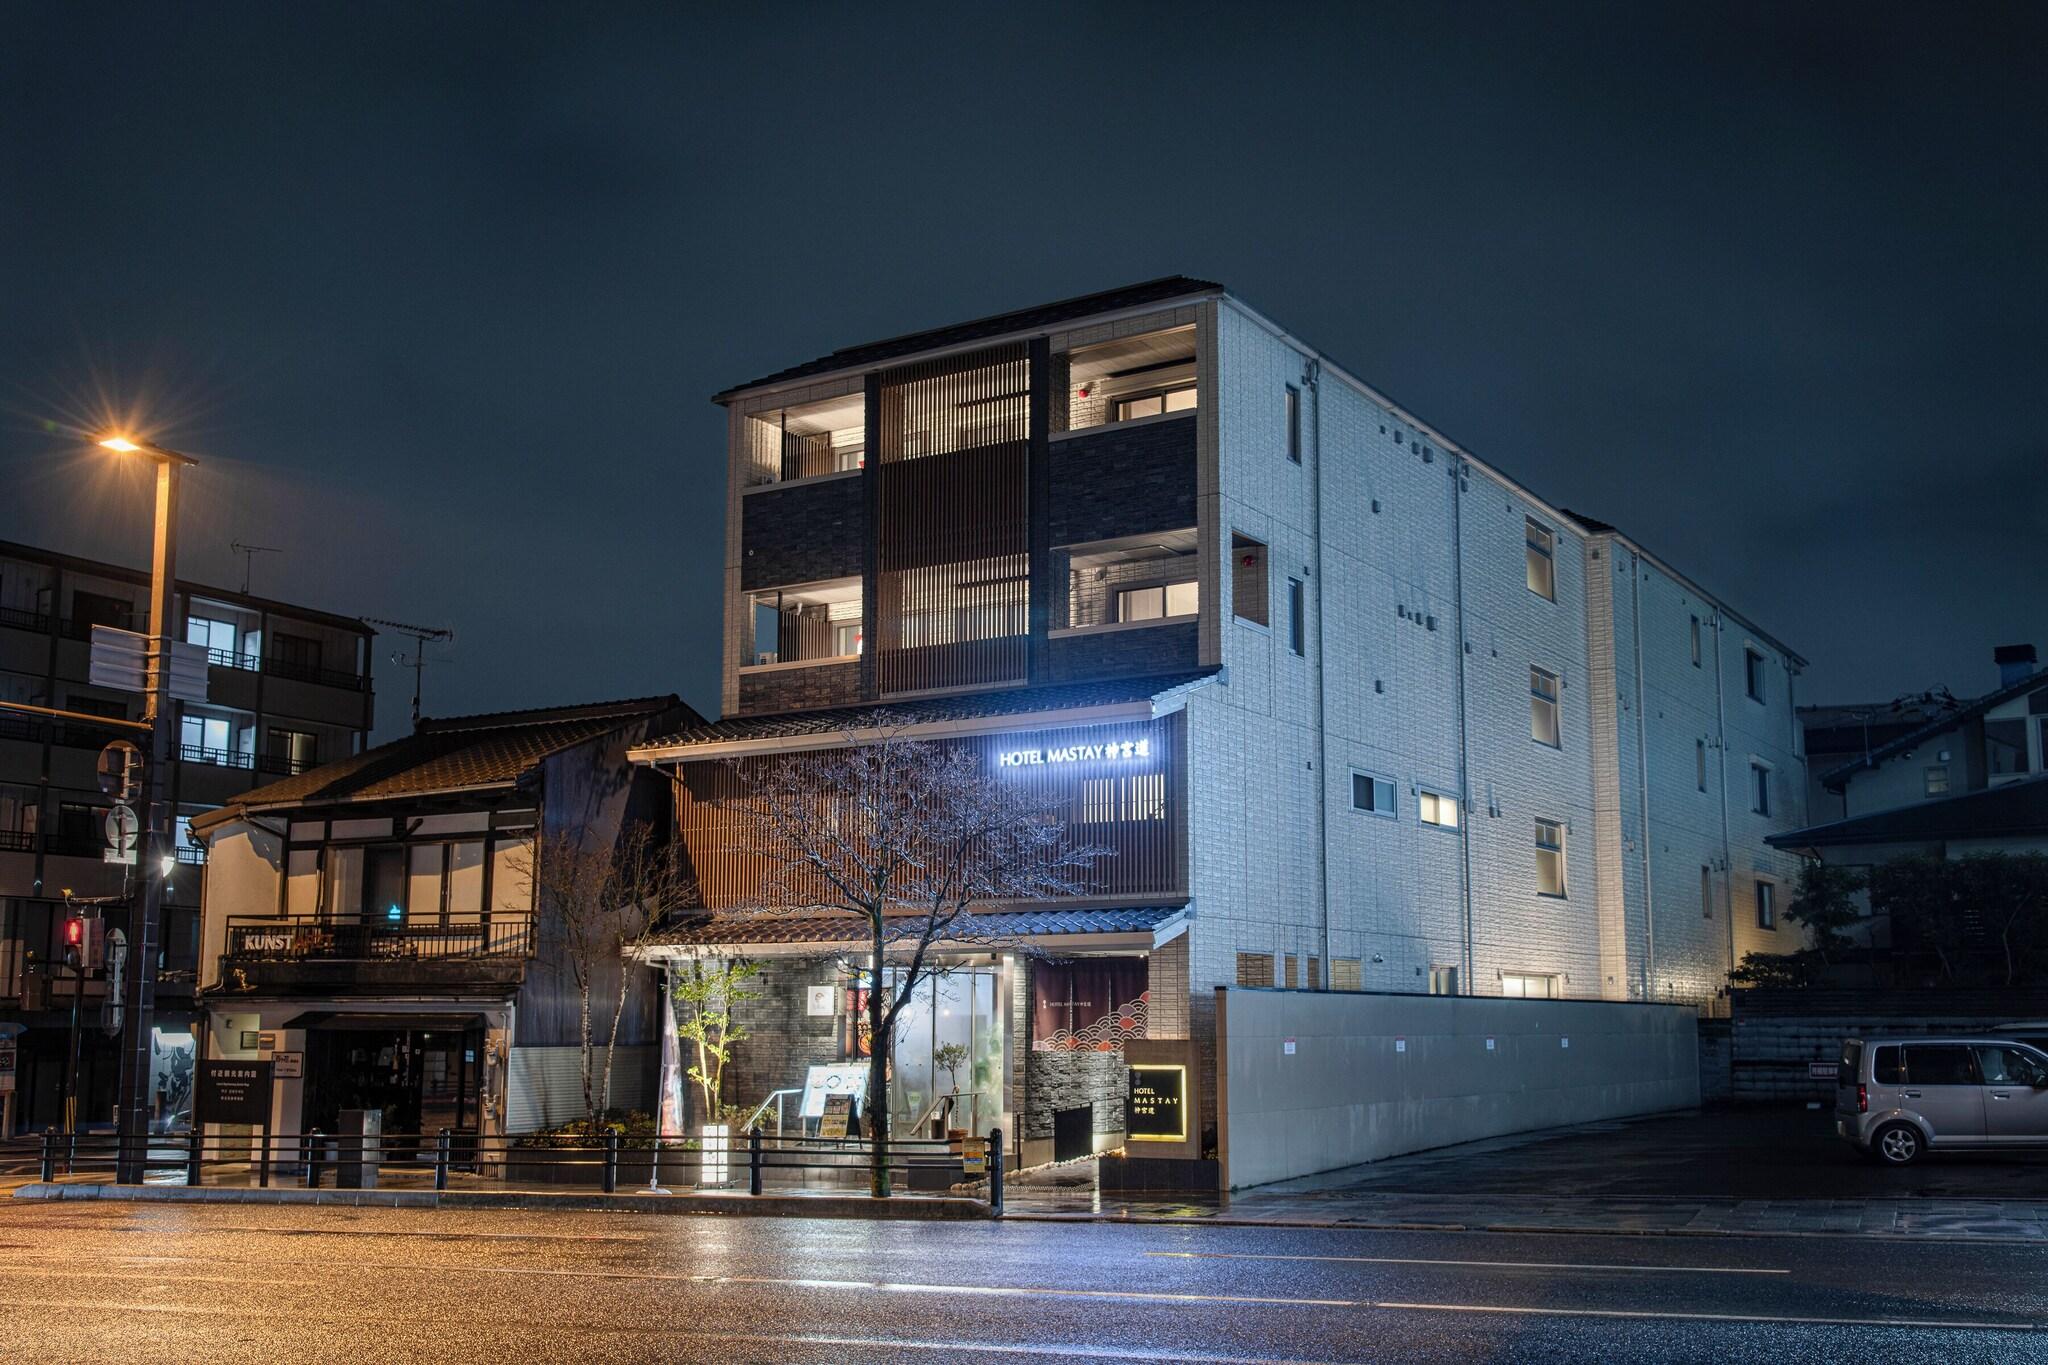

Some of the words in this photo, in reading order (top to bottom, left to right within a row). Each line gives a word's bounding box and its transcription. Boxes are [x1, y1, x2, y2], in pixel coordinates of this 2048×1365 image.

[1000, 751, 1044, 767] HOTEL
[1047, 745, 1103, 764] MASTAY
[244, 934, 294, 950] KUNST
[1133, 1087, 1155, 1095] HOTEL
[1133, 1097, 1178, 1105] MASTAY
